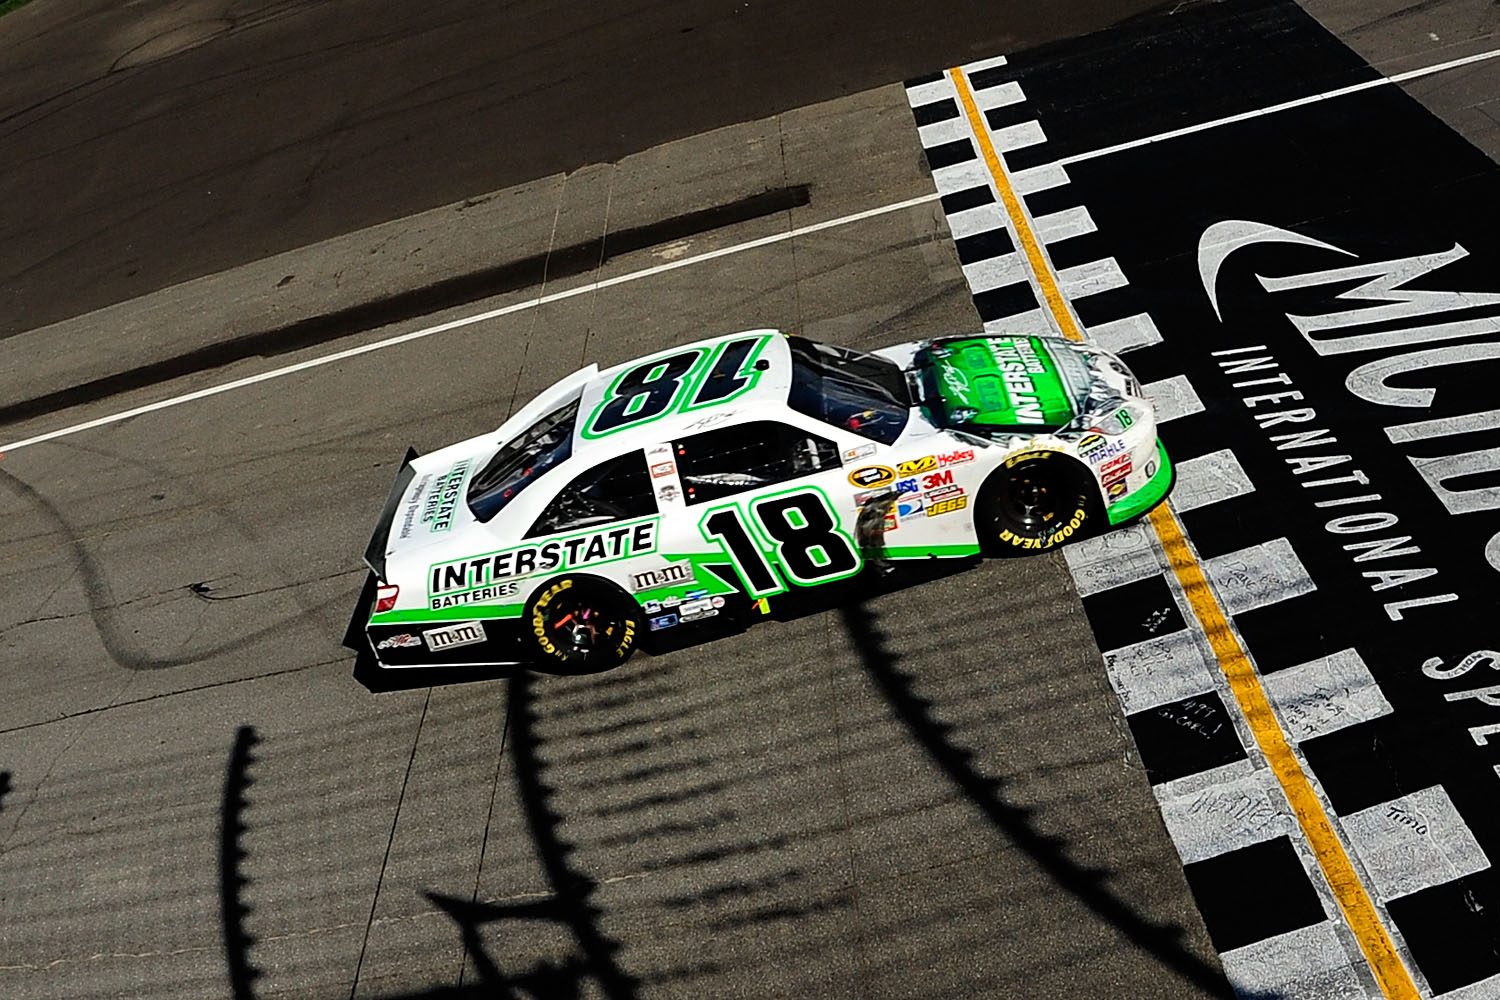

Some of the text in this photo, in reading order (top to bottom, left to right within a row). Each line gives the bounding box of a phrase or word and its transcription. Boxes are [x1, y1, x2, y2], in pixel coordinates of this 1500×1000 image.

[585, 335, 770, 437] 18
[1114, 408, 1134, 430] 18
[937, 449, 975, 466] Holley
[1088, 439, 1127, 465] MAHLE
[423, 474, 448, 522] BATTERIES
[434, 459, 468, 530] INTERSTATE
[922, 469, 954, 490] 3M
[1211, 345, 1459, 621] INTERNATIONAL
[926, 495, 969, 518] JEGS
[702, 487, 860, 596] 18
[999, 508, 1086, 549] GOODYEAR
[432, 523, 655, 594] INTERSTATE
[431, 582, 518, 610] BATTERIES
[532, 578, 573, 654] GOODYEAR
[616, 619, 636, 658] EAGLE
